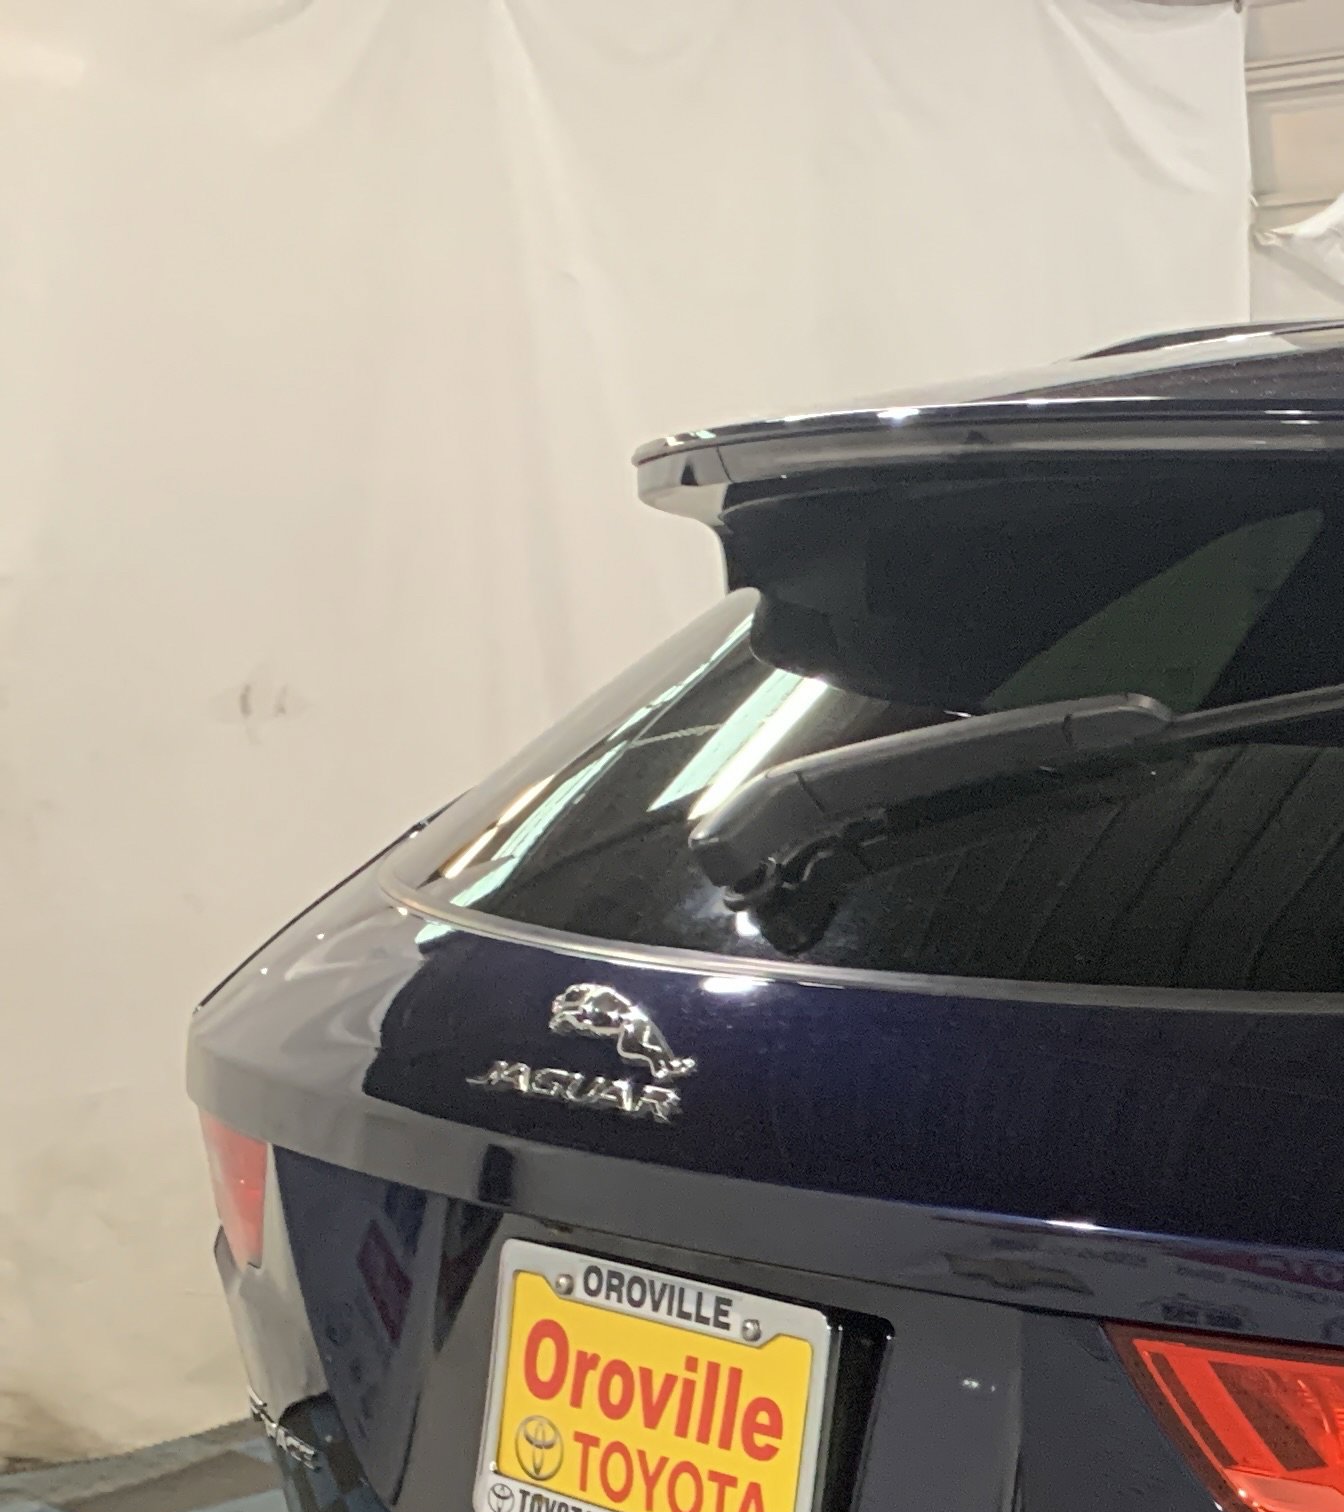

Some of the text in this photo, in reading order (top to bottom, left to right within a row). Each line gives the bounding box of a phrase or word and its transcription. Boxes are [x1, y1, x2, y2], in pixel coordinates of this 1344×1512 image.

[465, 1060, 681, 1124] JAGUAR
[583, 1265, 733, 1331] OROVILLE
[524, 1319, 784, 1462] Oroville
